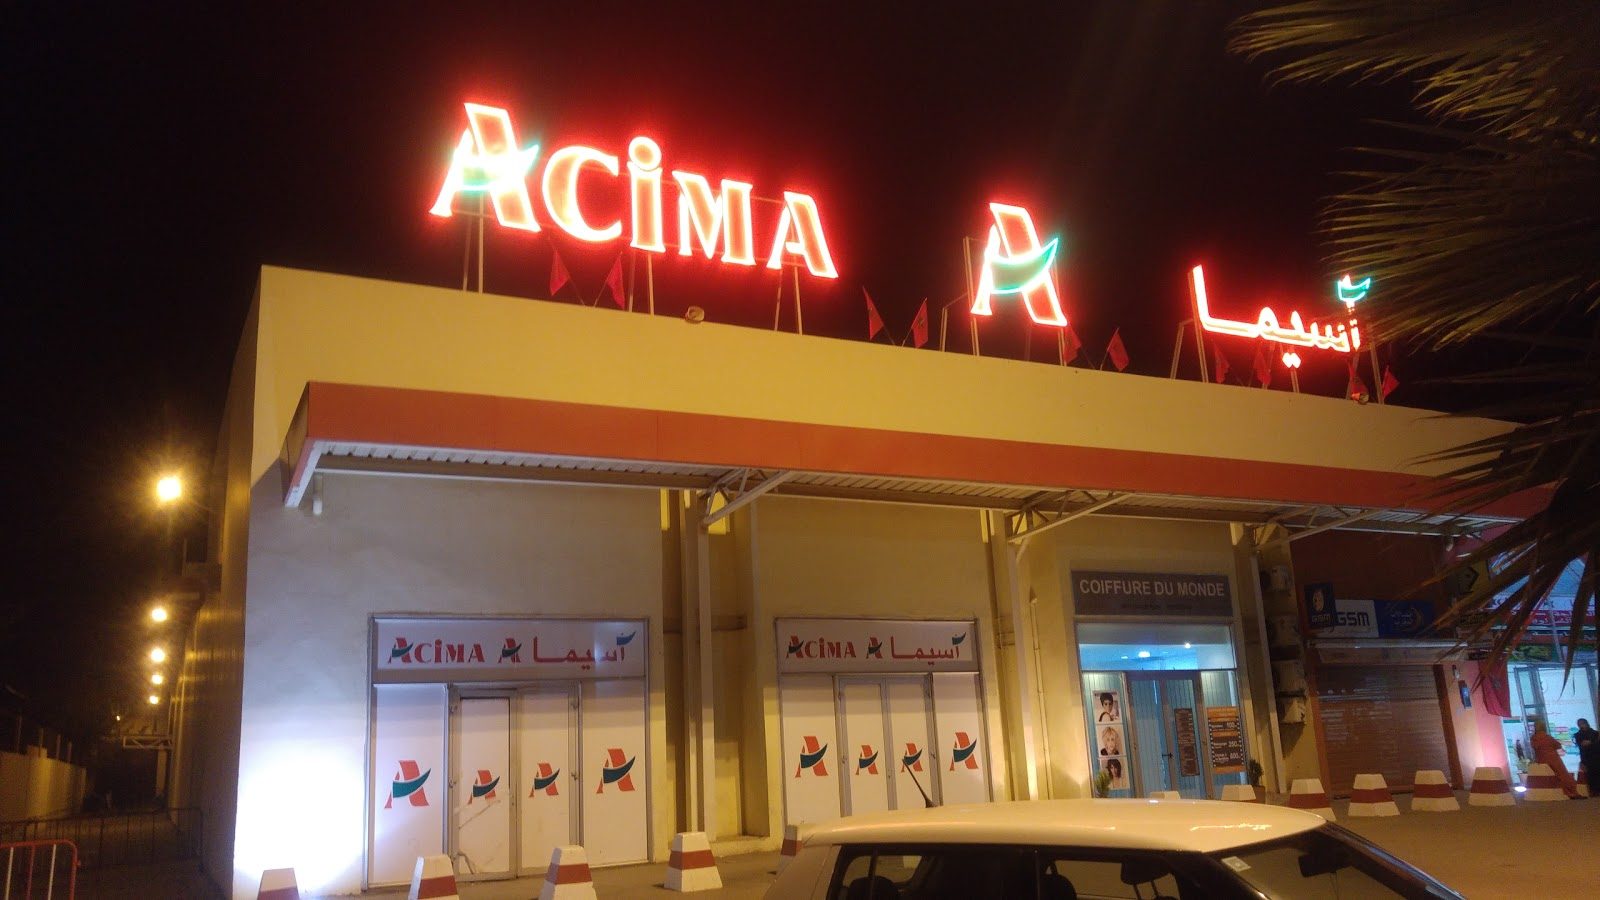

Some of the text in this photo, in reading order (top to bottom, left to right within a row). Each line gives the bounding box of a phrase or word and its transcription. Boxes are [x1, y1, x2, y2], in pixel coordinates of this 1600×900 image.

[1079, 579, 1225, 597] COIFFURE DU MONDE
[1335, 611, 1370, 627] GSM
